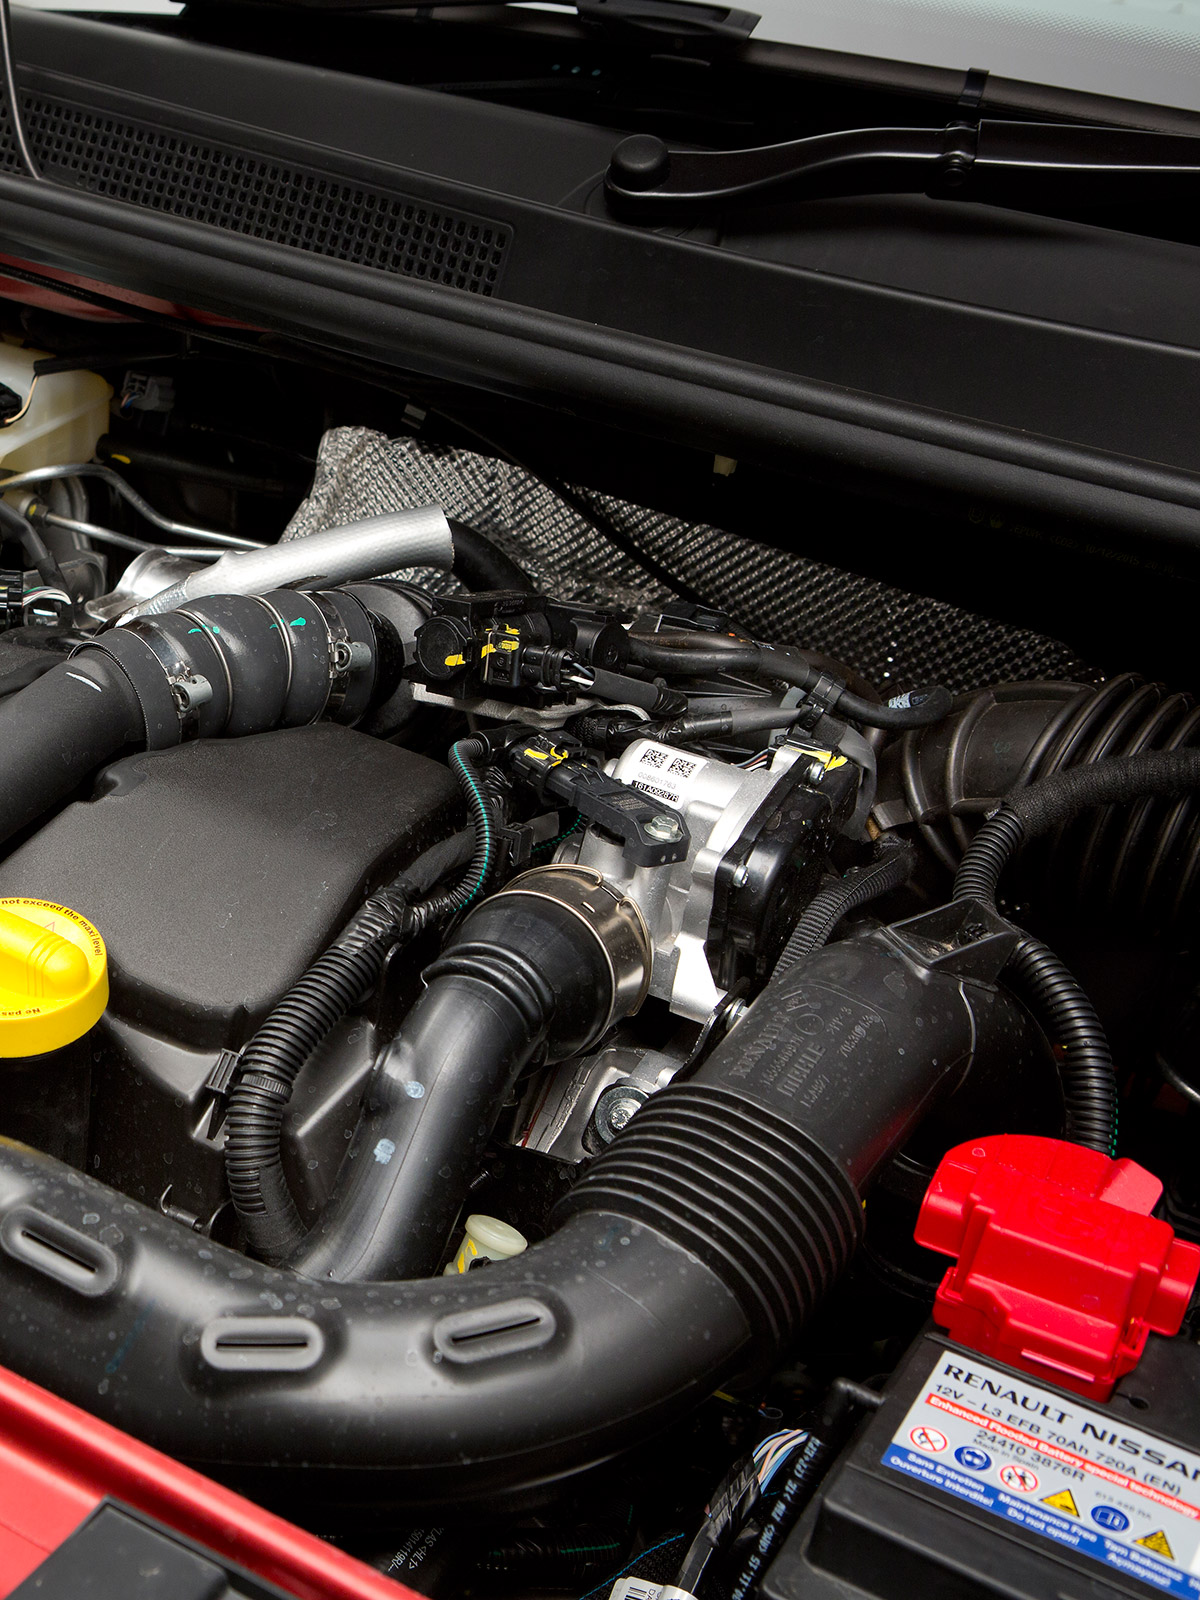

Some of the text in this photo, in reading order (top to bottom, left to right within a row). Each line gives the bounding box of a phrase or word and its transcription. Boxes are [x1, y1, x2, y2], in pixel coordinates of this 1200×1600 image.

[1, 898, 21, 906] not
[22, 899, 64, 913] exceed
[62, 908, 80, 922] the
[78, 919, 99, 939] maxi
[93, 936, 104, 957] level
[1, 1009, 23, 1017] pas
[25, 1007, 41, 1015] Ne
[943, 1364, 1073, 1426] RENAULT
[930, 1395, 989, 1426] Enhanced
[988, 1421, 1038, 1447] Flooded
[1037, 1442, 1085, 1468] Battery
[1083, 1461, 1131, 1487] special
[1127, 1480, 1200, 1519] technology
[934, 1383, 964, 1400] 12V
[981, 1403, 1003, 1417] L3
[1006, 1414, 1042, 1434] EFB
[1044, 1430, 1091, 1455] 70Ah
[1093, 1451, 1140, 1476] 720A
[1141, 1471, 1183, 1495] (EN)
[976, 1429, 1086, 1481] 24410 3876R
[890, 1454, 945, 1485] Ouverture
[907, 1452, 986, 1492] Sans Entretien
[997, 1492, 1071, 1530] Maintenance
[1069, 1524, 1099, 1543] Free
[1006, 1507, 1026, 1521] Do
[1024, 1515, 1046, 1530] not
